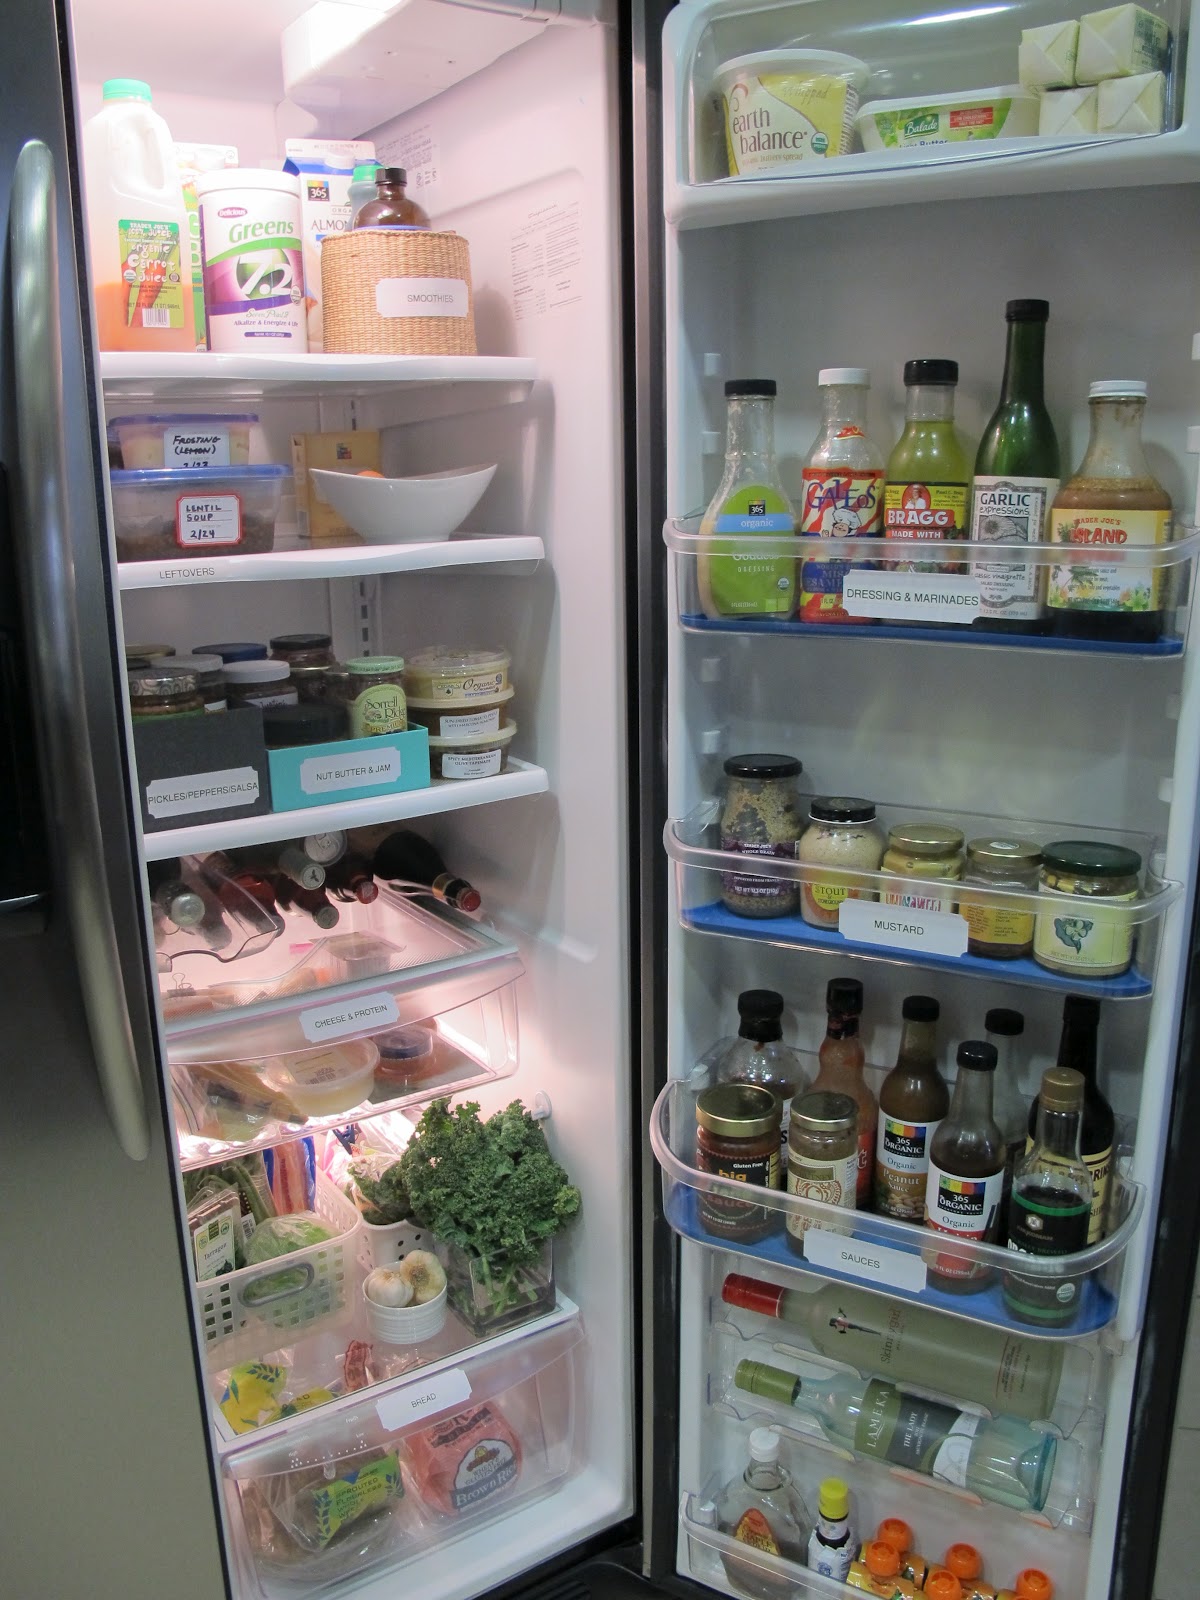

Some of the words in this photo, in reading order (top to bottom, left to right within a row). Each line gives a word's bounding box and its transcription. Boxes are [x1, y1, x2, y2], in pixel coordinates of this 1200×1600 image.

[733, 108, 770, 134] earth
[906, 119, 938, 136] Balade
[740, 131, 804, 155] balance
[310, 187, 327, 198] 365
[219, 208, 246, 217] Delicious
[229, 220, 294, 244] Greens
[127, 253, 176, 271] Carrot
[138, 268, 168, 283] Juice
[238, 248, 293, 296] 7.2
[407, 295, 454, 303] SMOOTHIES
[263, 319, 287, 327] Energize
[173, 435, 222, 445] FROSTING
[174, 445, 217, 456] (LEMON)
[980, 493, 1031, 507] GARLIC
[186, 504, 223, 512] LENTIL
[751, 505, 764, 514] 365
[979, 506, 1031, 516] expressions
[186, 513, 214, 523] SOUP
[740, 519, 774, 530] organic
[888, 510, 949, 526] BRAGG
[1100, 517, 1121, 526] JOE'S
[190, 529, 216, 541] 2/24
[891, 530, 914, 538] MADE
[916, 531, 941, 539] WITH
[1070, 527, 1128, 545] ISLAND
[159, 567, 215, 580] LEFTOVERS
[847, 588, 901, 601] DRESSING
[904, 592, 911, 602] &
[914, 593, 979, 606] MARINADES
[366, 696, 398, 710] Sorrell
[316, 771, 333, 781] NUT
[334, 767, 367, 779] BUTTER
[369, 766, 374, 774] &
[375, 763, 391, 773] JAM
[148, 782, 259, 805] PICKLES/PEPPERS/SALSA
[814, 886, 846, 896] STOUT
[874, 920, 924, 936] MUSTARD
[314, 1014, 346, 1029] CHEESE
[347, 1012, 354, 1020] &
[354, 1004, 388, 1019] PROTEIN
[884, 1137, 923, 1155] ORGANIC
[896, 1136, 911, 1146] 365
[887, 1156, 917, 1170] Organic
[883, 1167, 920, 1185] Peanut
[887, 1181, 909, 1193] Sauce
[939, 1195, 982, 1211] ORGANIC
[953, 1194, 969, 1204] 365
[942, 1215, 975, 1228] Organic
[204, 1243, 227, 1260] Tarragon
[841, 1251, 880, 1269] SAUCES
[411, 1392, 437, 1409] BREAD
[907, 1411, 918, 1432] LADY
[903, 1432, 912, 1448] THE
[336, 1477, 378, 1498] SPROUTED
[456, 1479, 497, 1507] Brown
[496, 1464, 517, 1487] Ric
